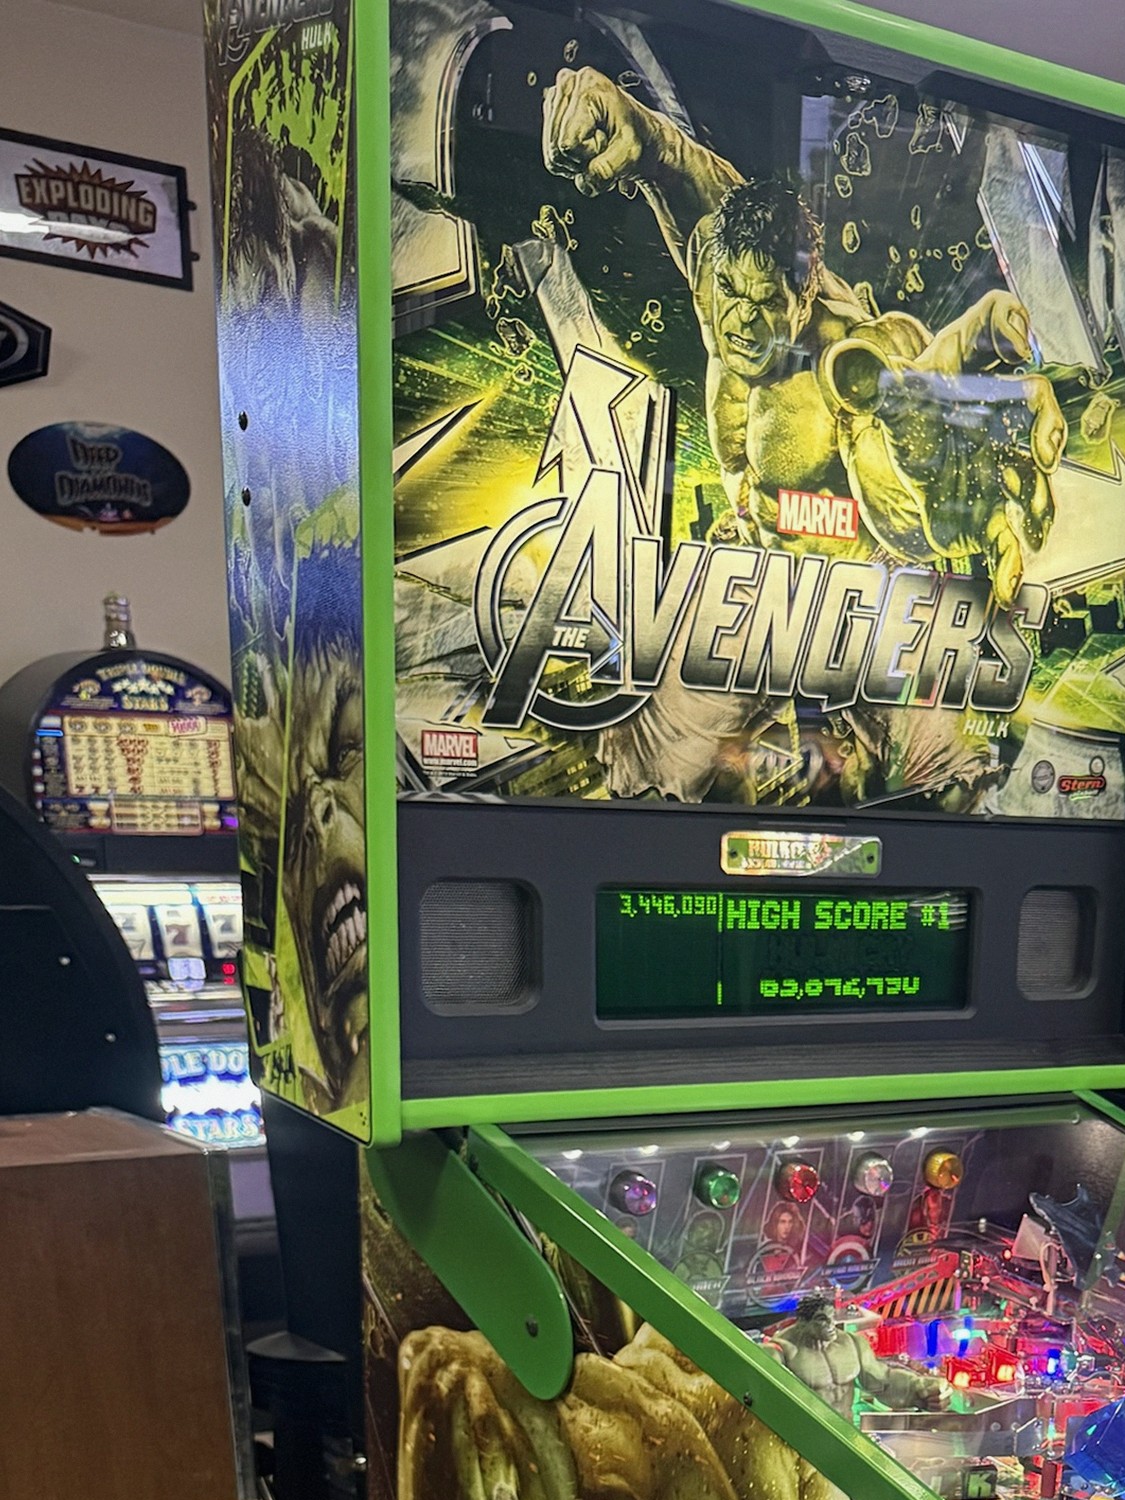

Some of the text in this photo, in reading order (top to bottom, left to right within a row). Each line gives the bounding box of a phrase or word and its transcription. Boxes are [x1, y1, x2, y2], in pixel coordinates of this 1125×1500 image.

[302, 22, 333, 50] HULK
[19, 177, 154, 230] EXPLODING
[779, 493, 858, 539] MARVEL
[475, 467, 1053, 735] AVENGERS
[551, 625, 588, 649] THE
[962, 718, 1010, 738] HULK
[424, 732, 477, 758] MARVEL
[1060, 779, 1102, 793] Stern
[726, 899, 950, 930] HIGH SCORE #1
